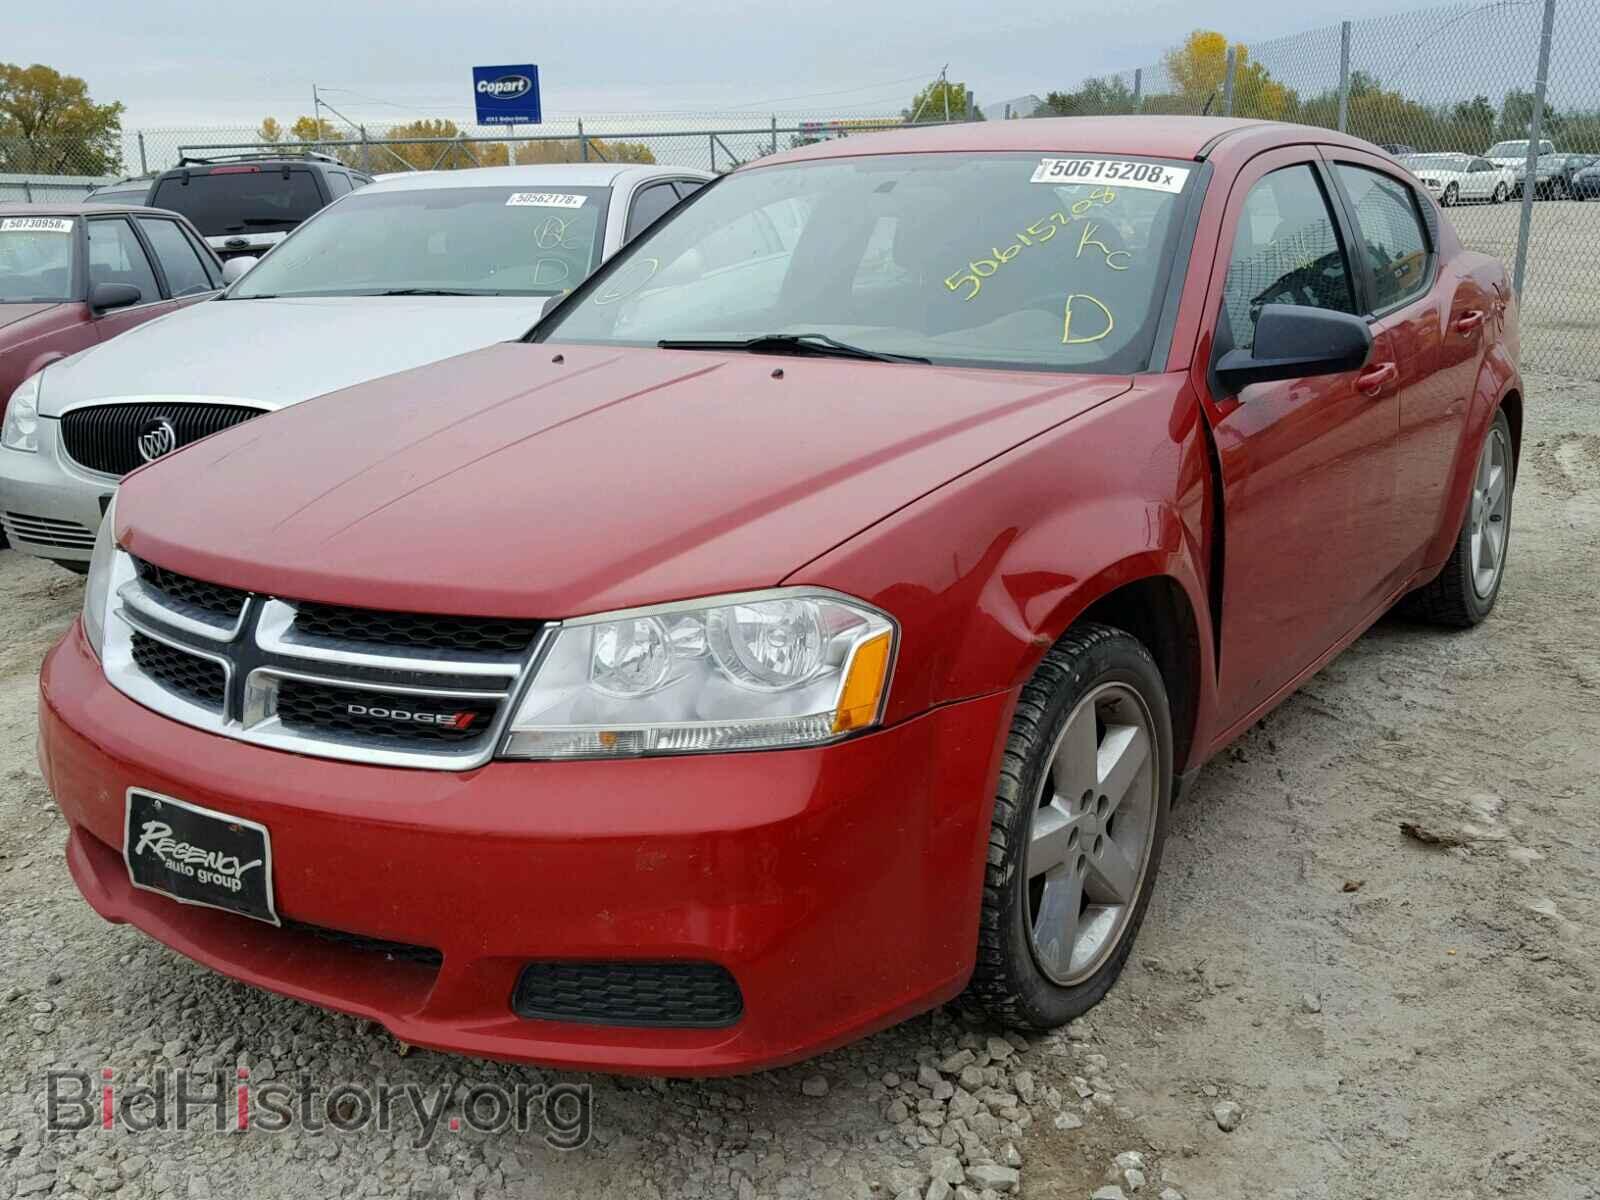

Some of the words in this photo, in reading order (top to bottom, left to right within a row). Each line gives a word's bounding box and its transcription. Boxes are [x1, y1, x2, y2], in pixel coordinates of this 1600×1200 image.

[477, 80, 525, 96] Copart
[1062, 294, 1114, 344] D
[347, 704, 457, 726] DODGE
[135, 820, 262, 880] REGENCY
[164, 857, 195, 877] auto
[197, 869, 242, 893] group
